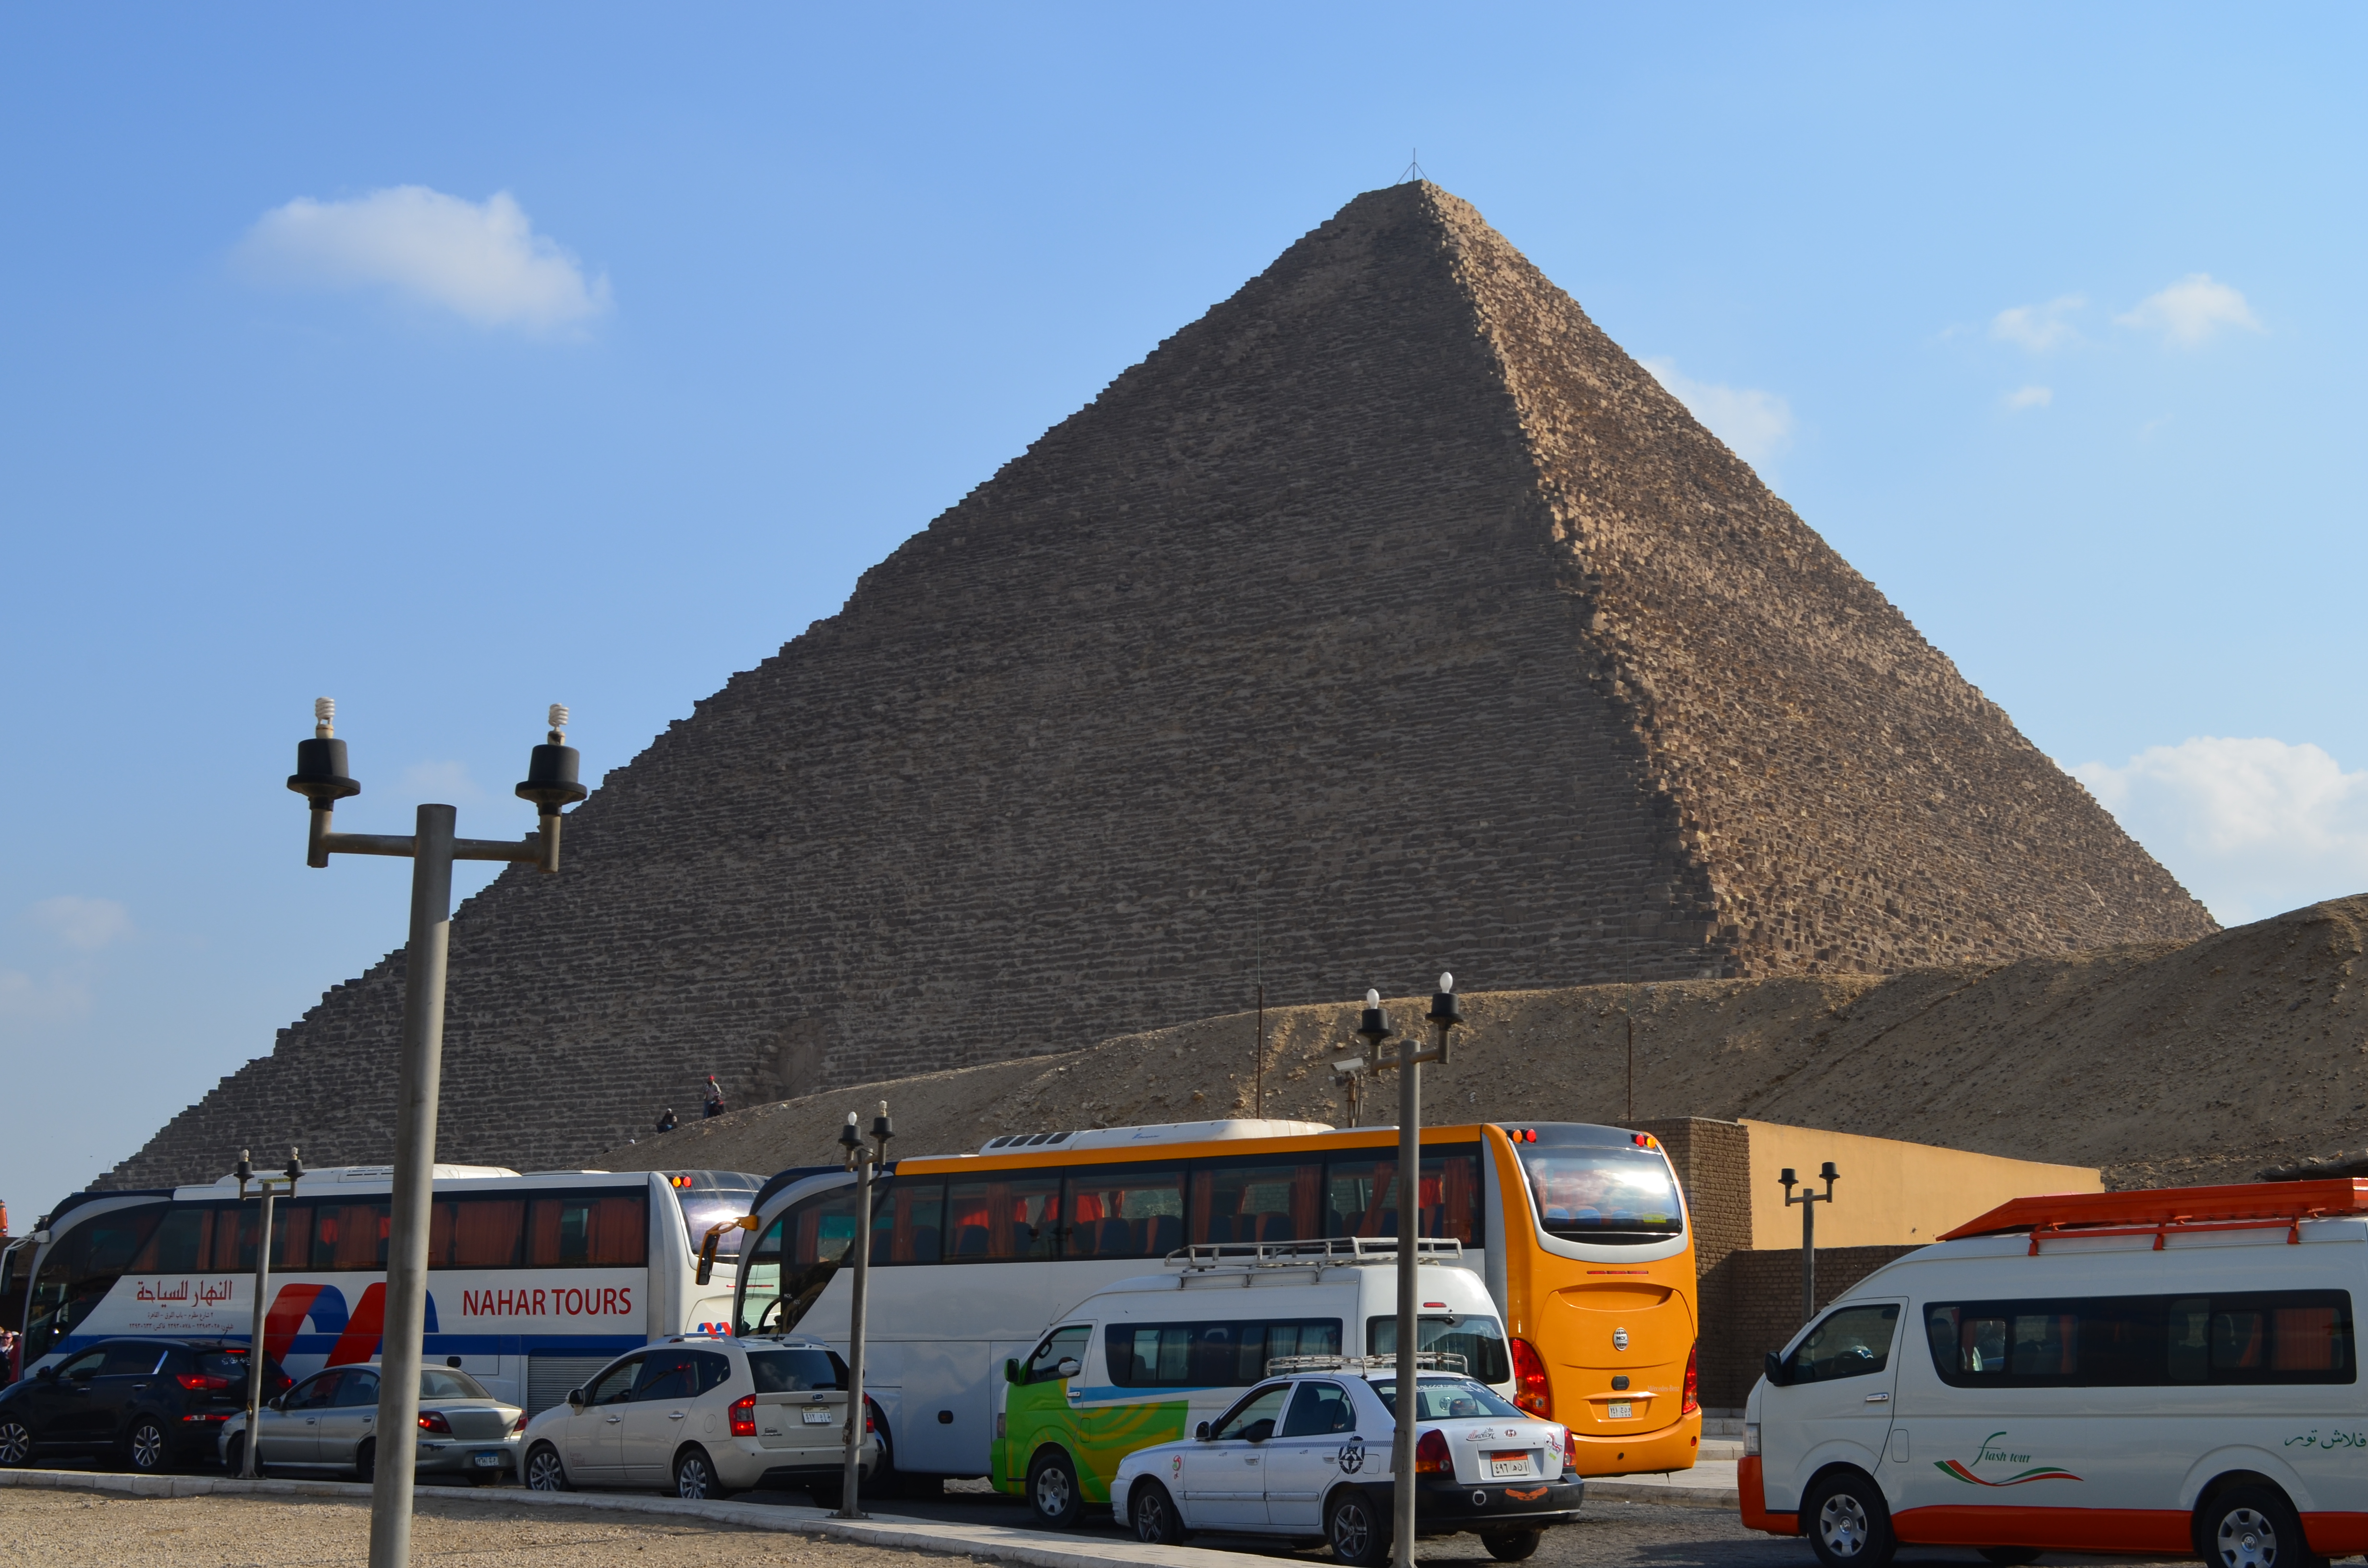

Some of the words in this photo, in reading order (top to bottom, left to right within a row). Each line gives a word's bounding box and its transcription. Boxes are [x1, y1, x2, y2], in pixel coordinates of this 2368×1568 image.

[137, 1279, 188, 1308] للسياحة
[191, 1279, 233, 1307] النهار
[463, 1289, 546, 1316] NAHAR
[551, 1287, 631, 1315] TOURS
[2284, 1430, 2318, 1446] تور
[2320, 1430, 2367, 1449] فلاش
[2010, 1453, 2032, 1463] tour
[1495, 1463, 1508, 1474] ٤٩٦
